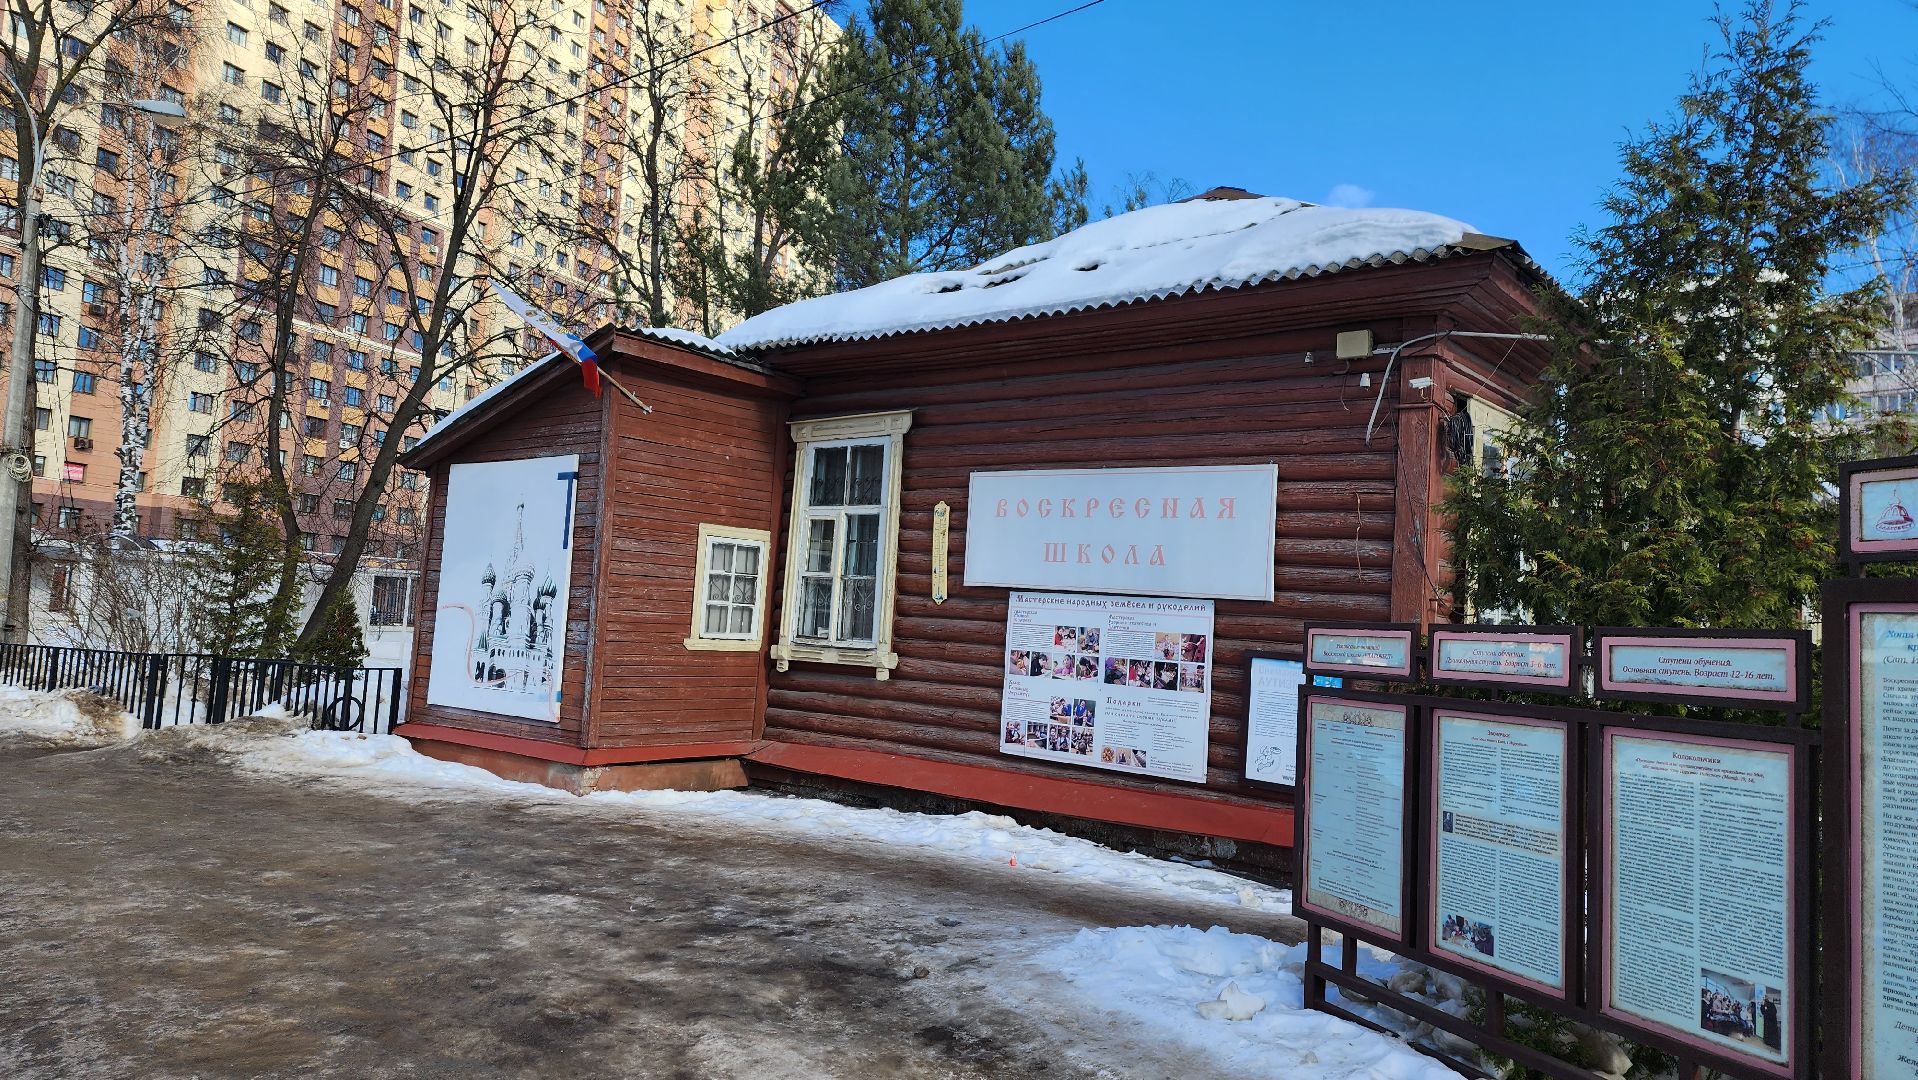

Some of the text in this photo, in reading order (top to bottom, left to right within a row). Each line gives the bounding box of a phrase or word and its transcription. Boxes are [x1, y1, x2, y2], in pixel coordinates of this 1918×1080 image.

[994, 497, 1238, 519] ВОСКРЕСНАЯ
[1042, 542, 1166, 566] ШКОЛА
[1015, 594, 1065, 606] Мастерские
[1066, 599, 1108, 609] народных
[1157, 602, 1206, 612] рукоделий
[1658, 656, 1692, 666] Ступени
[1622, 665, 1657, 675] Основная
[1694, 668, 1729, 678] Возраст
